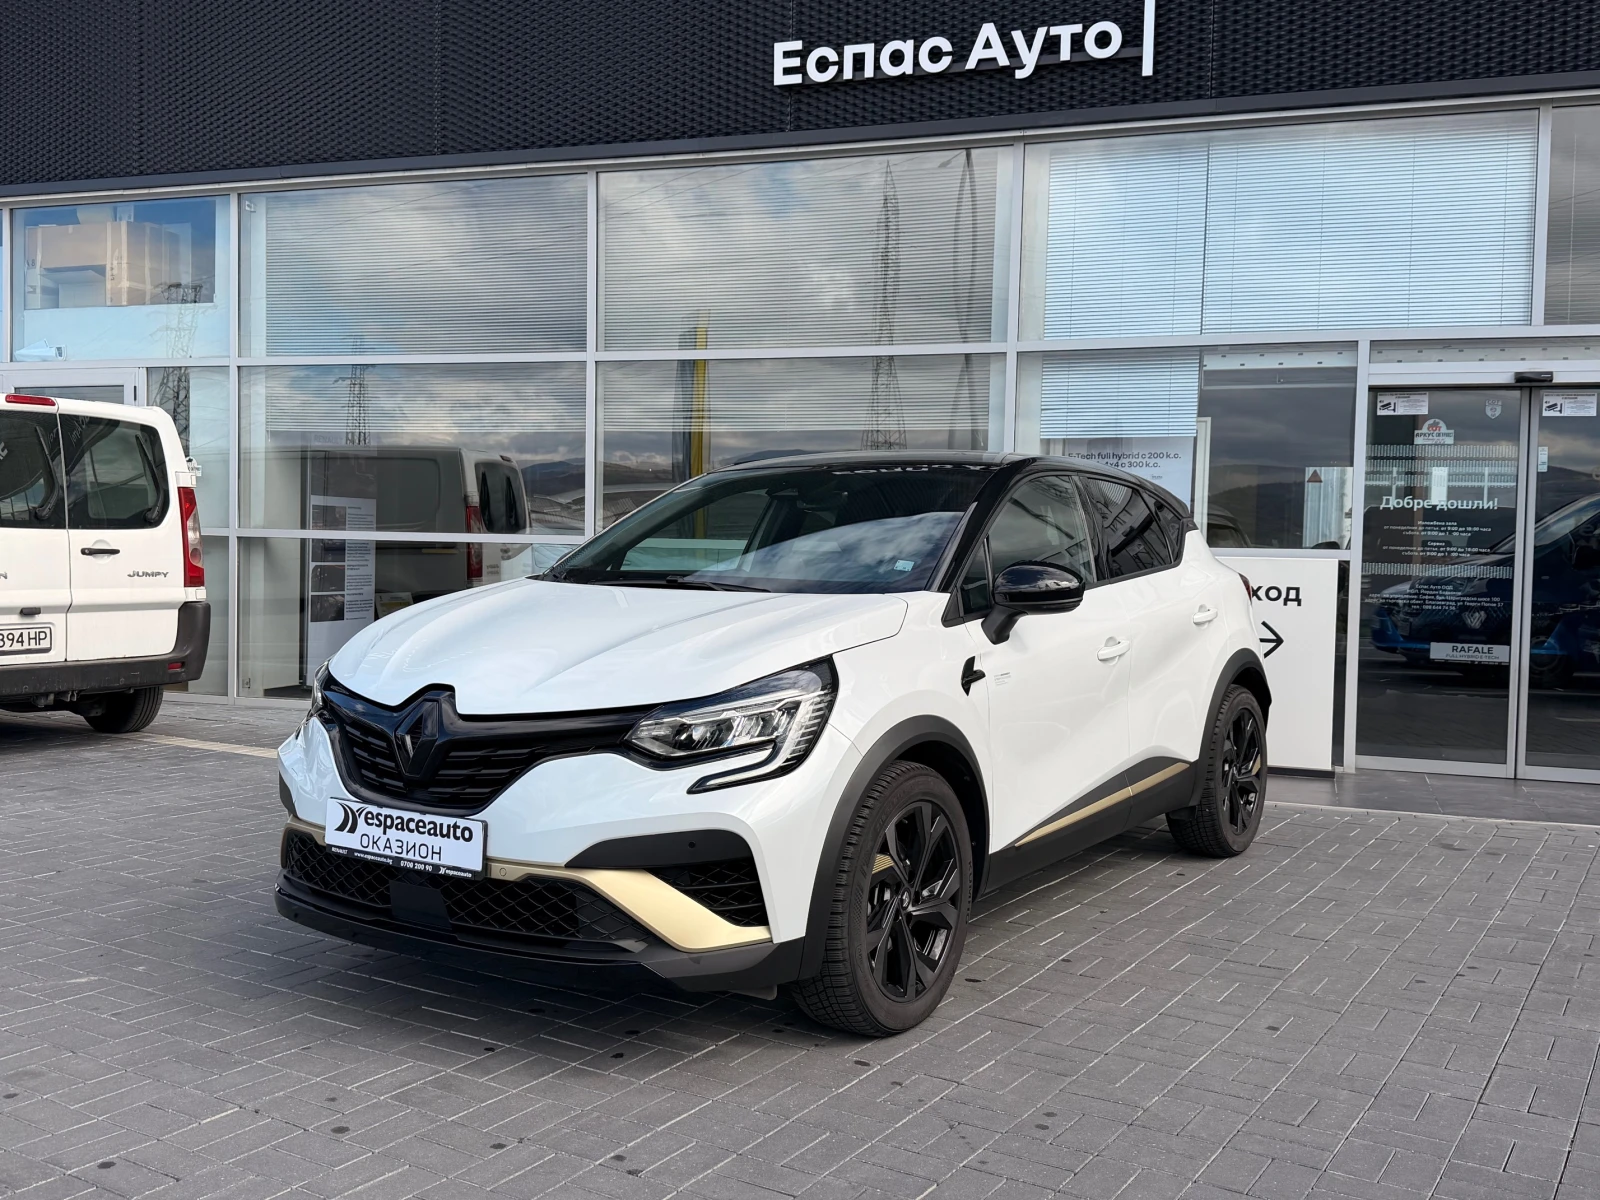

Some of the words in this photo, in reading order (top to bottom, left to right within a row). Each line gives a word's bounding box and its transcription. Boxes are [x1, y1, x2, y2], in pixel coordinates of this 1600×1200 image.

[773, 36, 953, 86] Еспас
[965, 21, 1122, 79] Ауто
[1097, 452, 1111, 460] full
[1112, 451, 1140, 461] hybrid
[1380, 495, 1433, 511] Добре
[1436, 498, 1498, 511] дошли!
[127, 570, 169, 578] JUMPY
[1451, 645, 1494, 655] RAFALE
[364, 810, 473, 843] espaceauto
[360, 833, 442, 862] ОКАЗИОН
[414, 862, 425, 871] 200
[425, 864, 433, 872] 90
[445, 868, 472, 878] espaceauto
